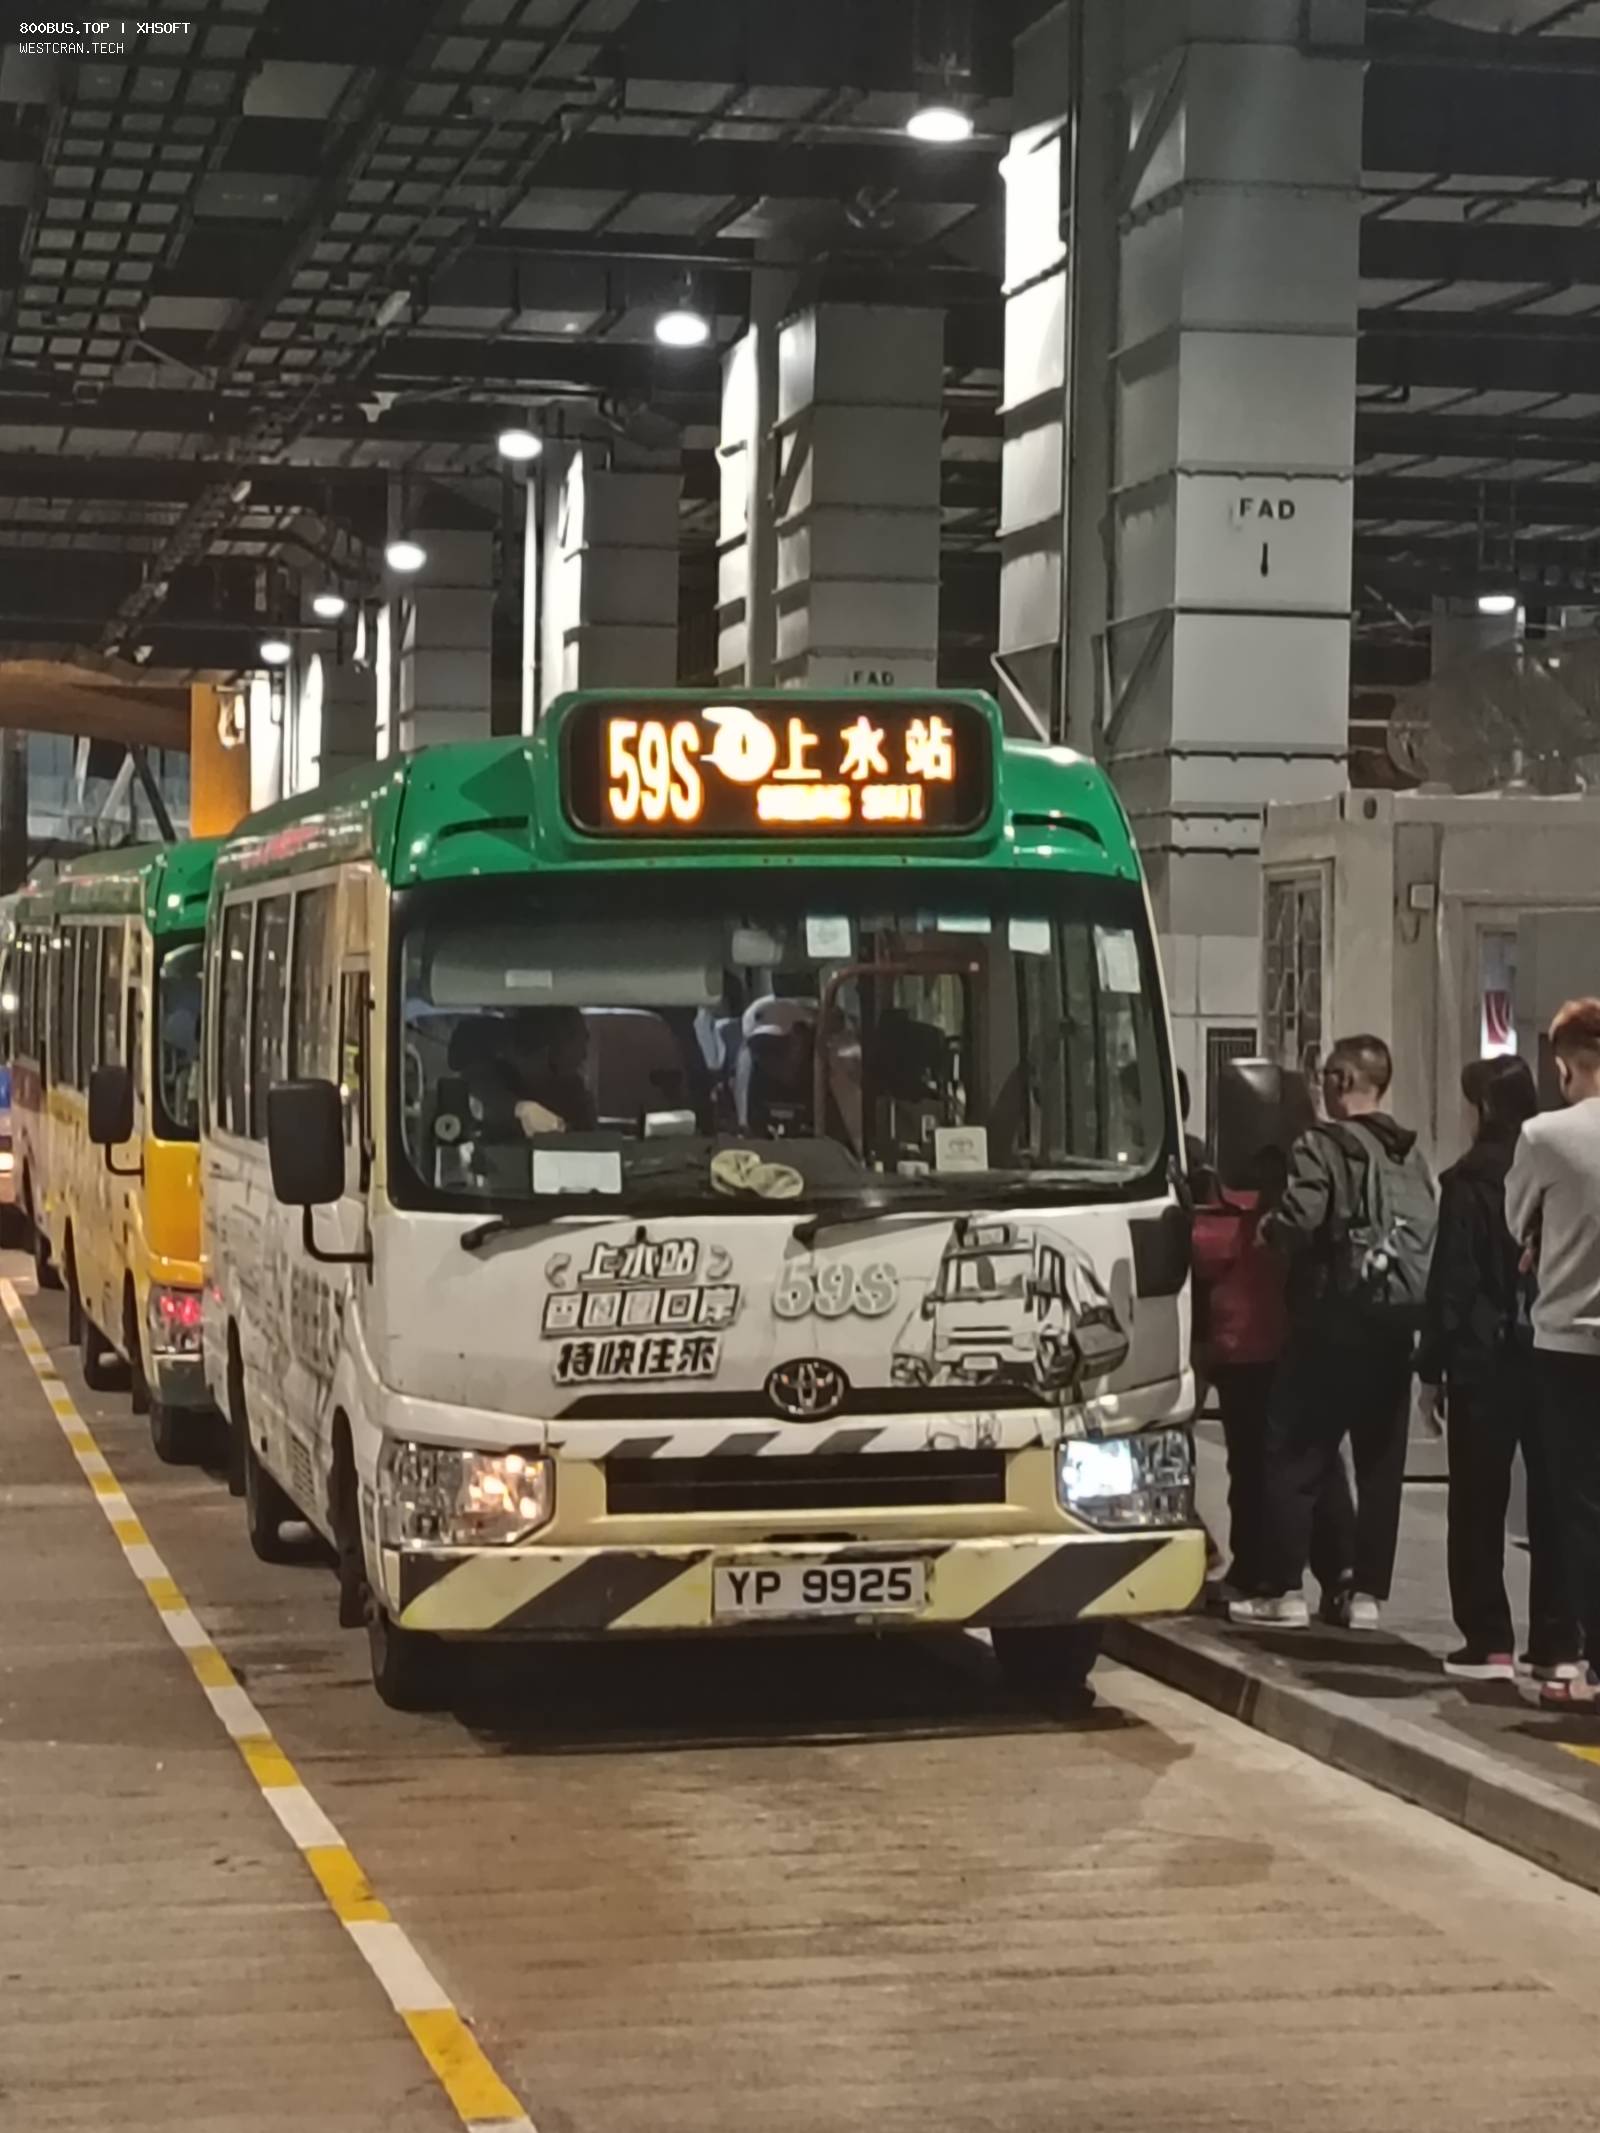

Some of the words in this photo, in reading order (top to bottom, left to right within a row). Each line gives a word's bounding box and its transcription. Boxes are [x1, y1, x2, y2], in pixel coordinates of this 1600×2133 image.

[1239, 496, 1296, 520] FAD
[852, 670, 895, 687] FAD
[608, 717, 705, 822] 59S
[772, 715, 954, 781] 上水站
[579, 1238, 698, 1284] 上水站
[773, 1258, 899, 1318] 59S
[727, 1570, 782, 1605] YP
[802, 1567, 912, 1604] 9925
